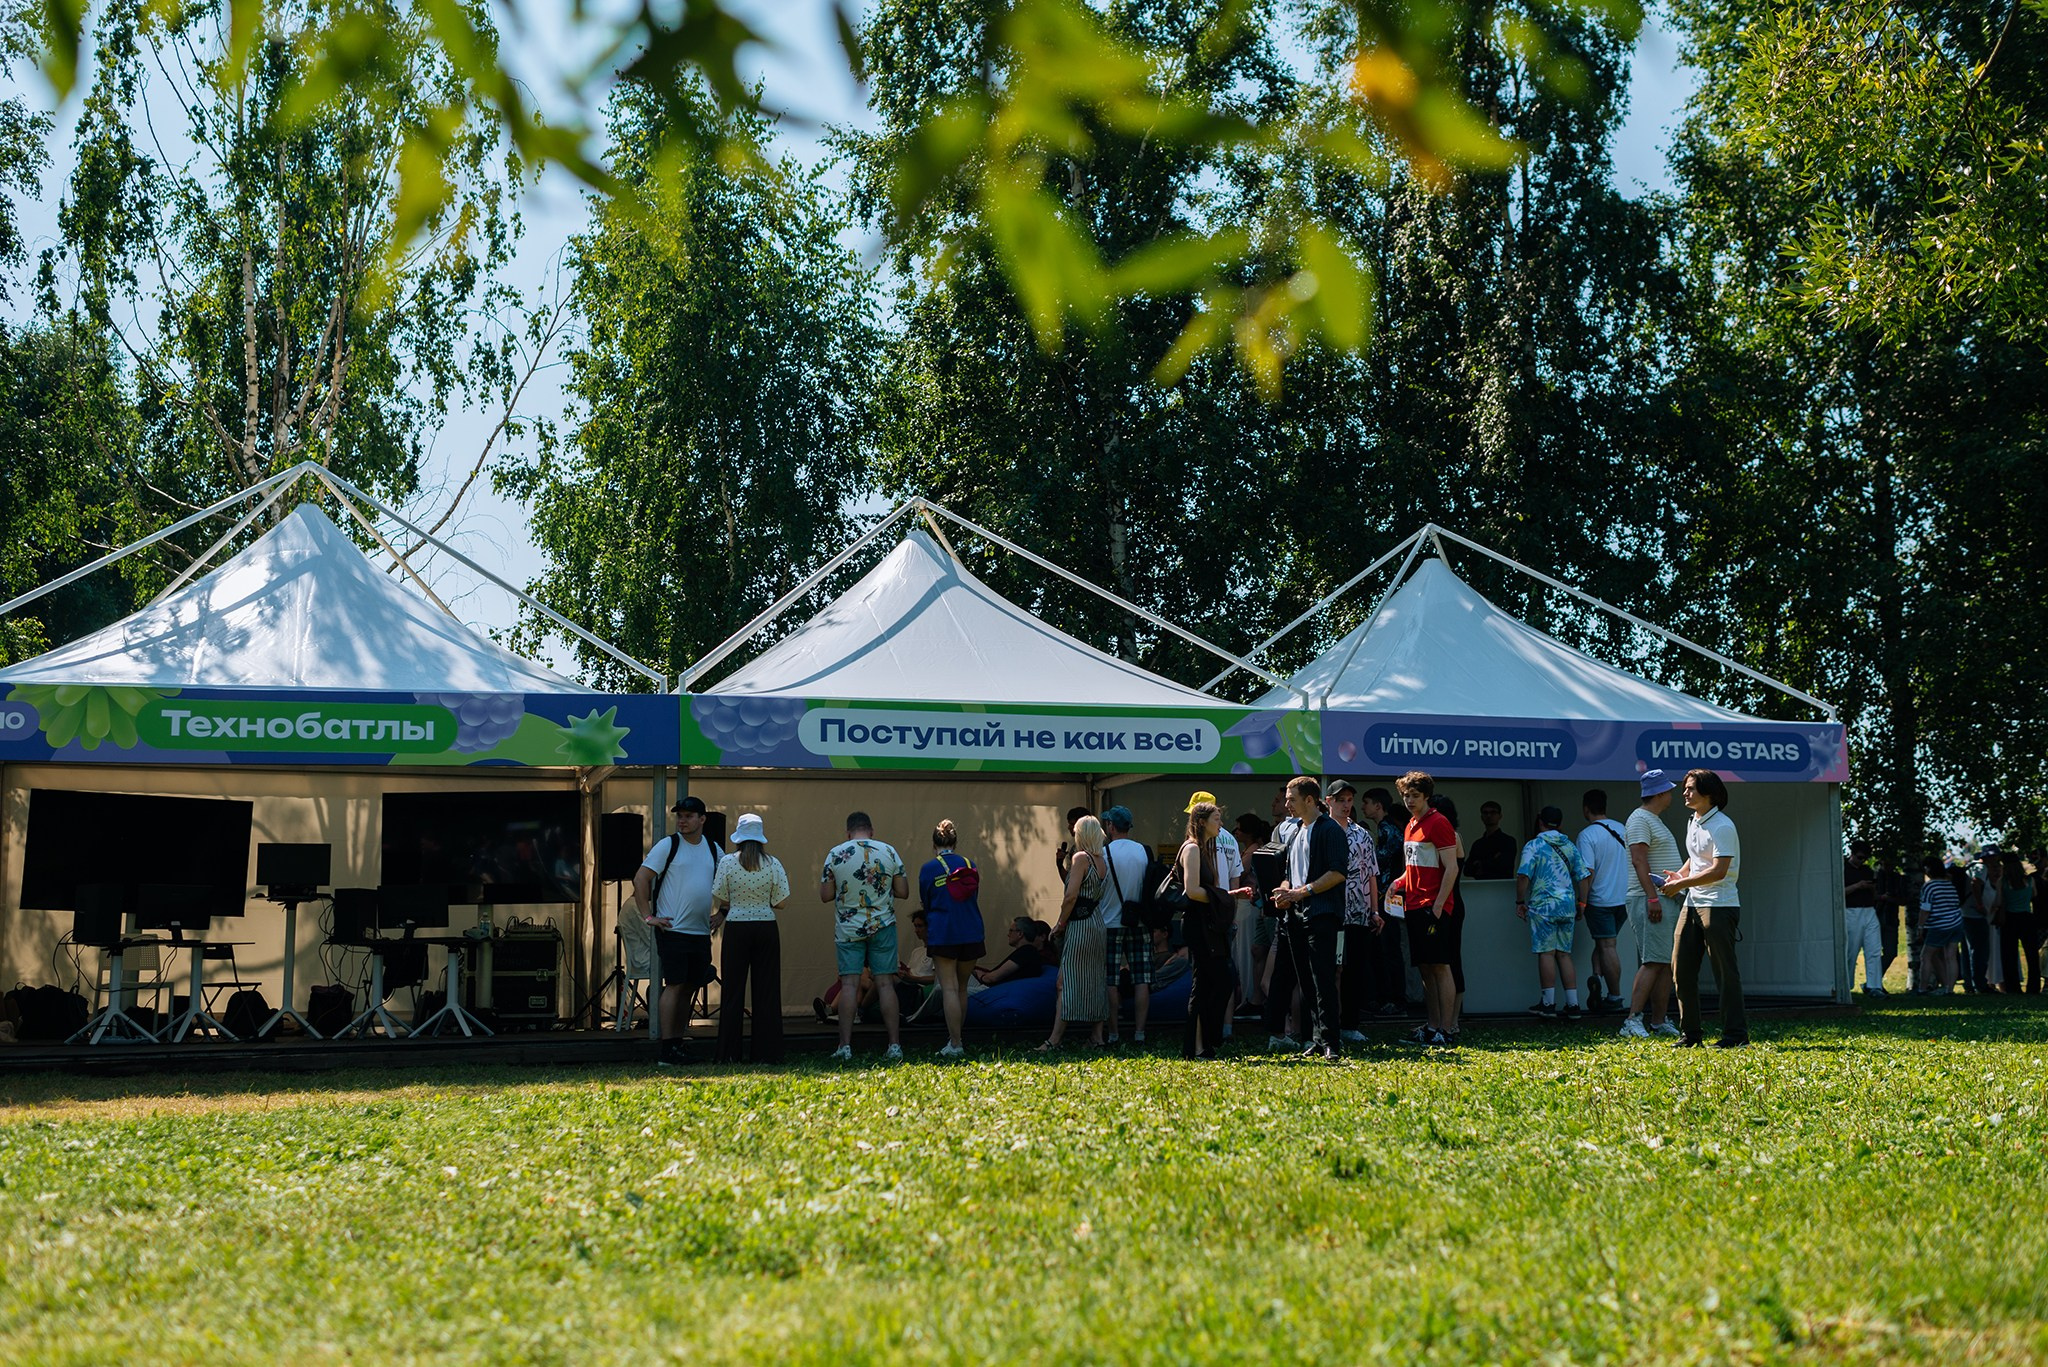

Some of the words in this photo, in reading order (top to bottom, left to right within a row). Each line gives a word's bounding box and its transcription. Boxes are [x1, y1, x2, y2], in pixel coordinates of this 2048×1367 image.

[161, 709, 435, 741] Технобатлы
[820, 718, 1005, 751] Поступай
[1013, 729, 1056, 749] не
[1063, 731, 1127, 751] как
[1133, 728, 1202, 752] все!
[1464, 739, 1562, 758] PRIORITY
[1651, 740, 1723, 759] ИТМО
[1727, 741, 1800, 761] STARS
